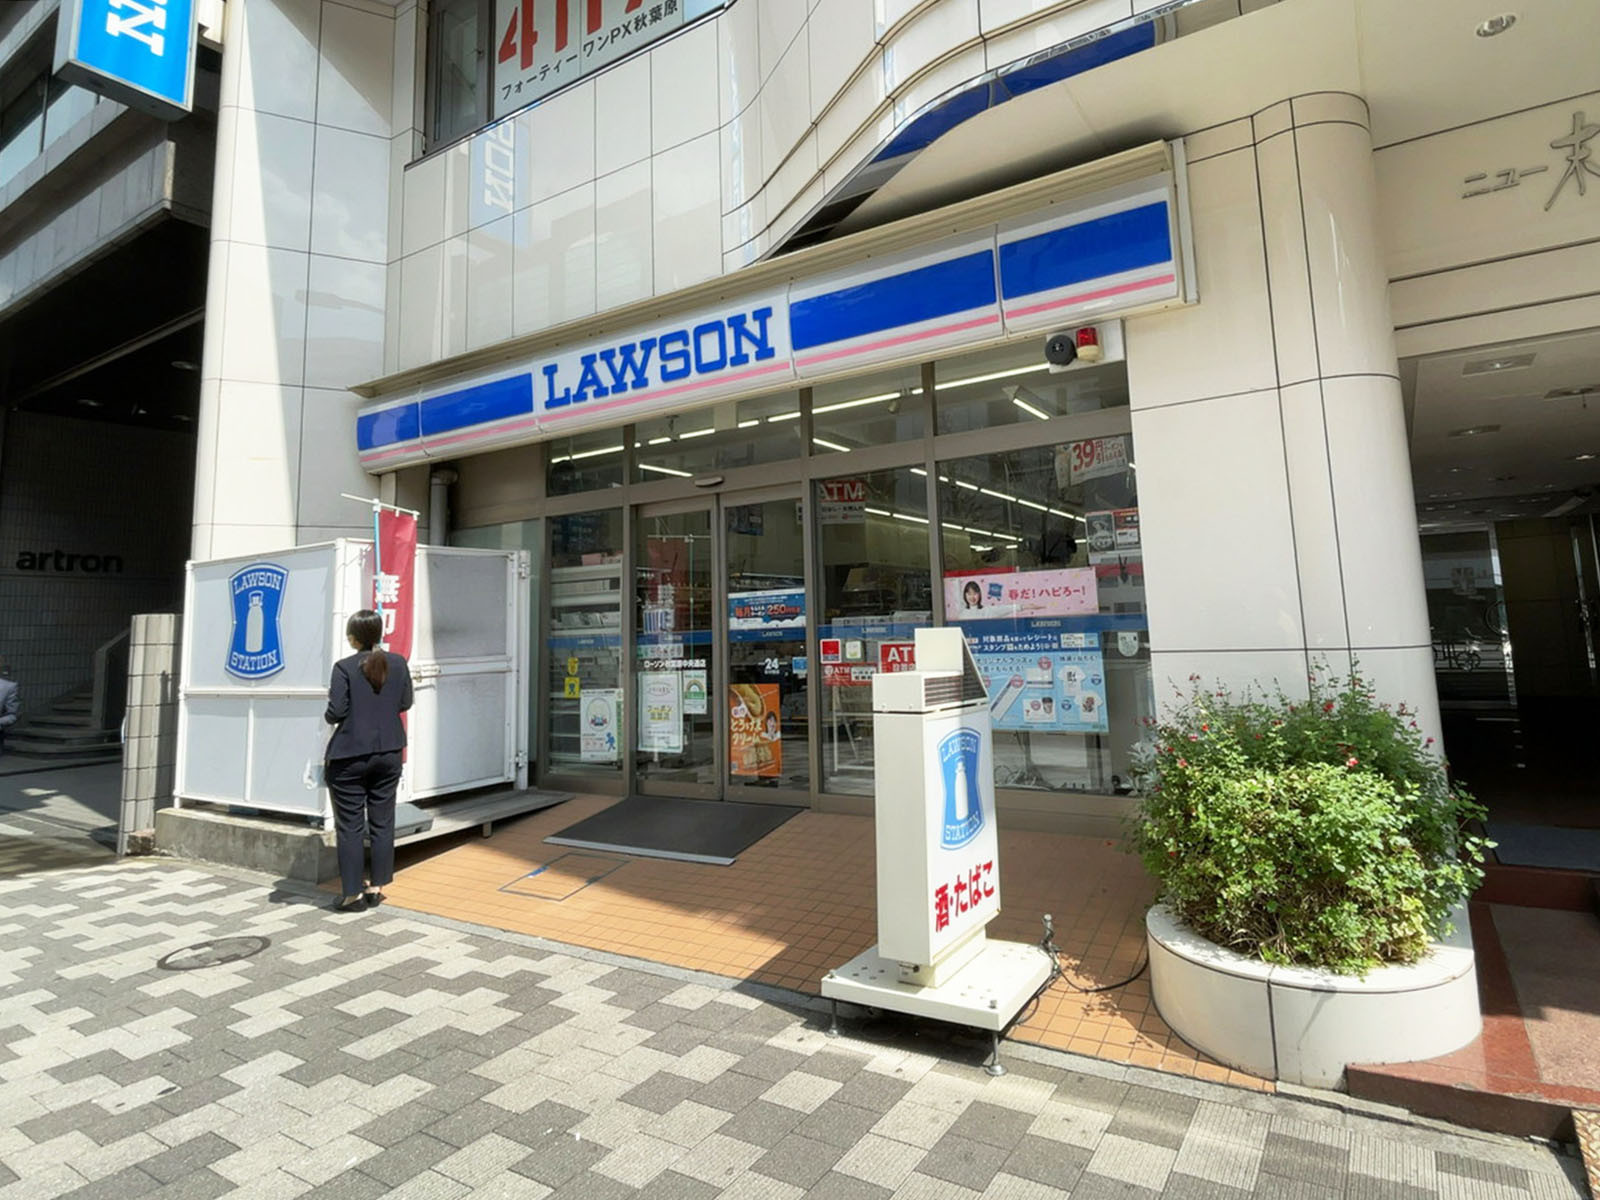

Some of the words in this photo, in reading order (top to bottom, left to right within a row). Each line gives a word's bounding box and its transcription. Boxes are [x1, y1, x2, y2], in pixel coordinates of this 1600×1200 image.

[502, 0, 678, 100] フォーティーワンPX秋葉原
[543, 306, 775, 410] LAWSON
[16, 550, 123, 572] artron
[234, 571, 283, 595] LAWSON
[231, 649, 278, 672] STATION
[764, 658, 779, 670] 24
[887, 647, 912, 663] AT
[942, 733, 977, 762] LAWSON
[945, 810, 979, 842] STATION
[935, 860, 995, 932] 酒・たばこ
